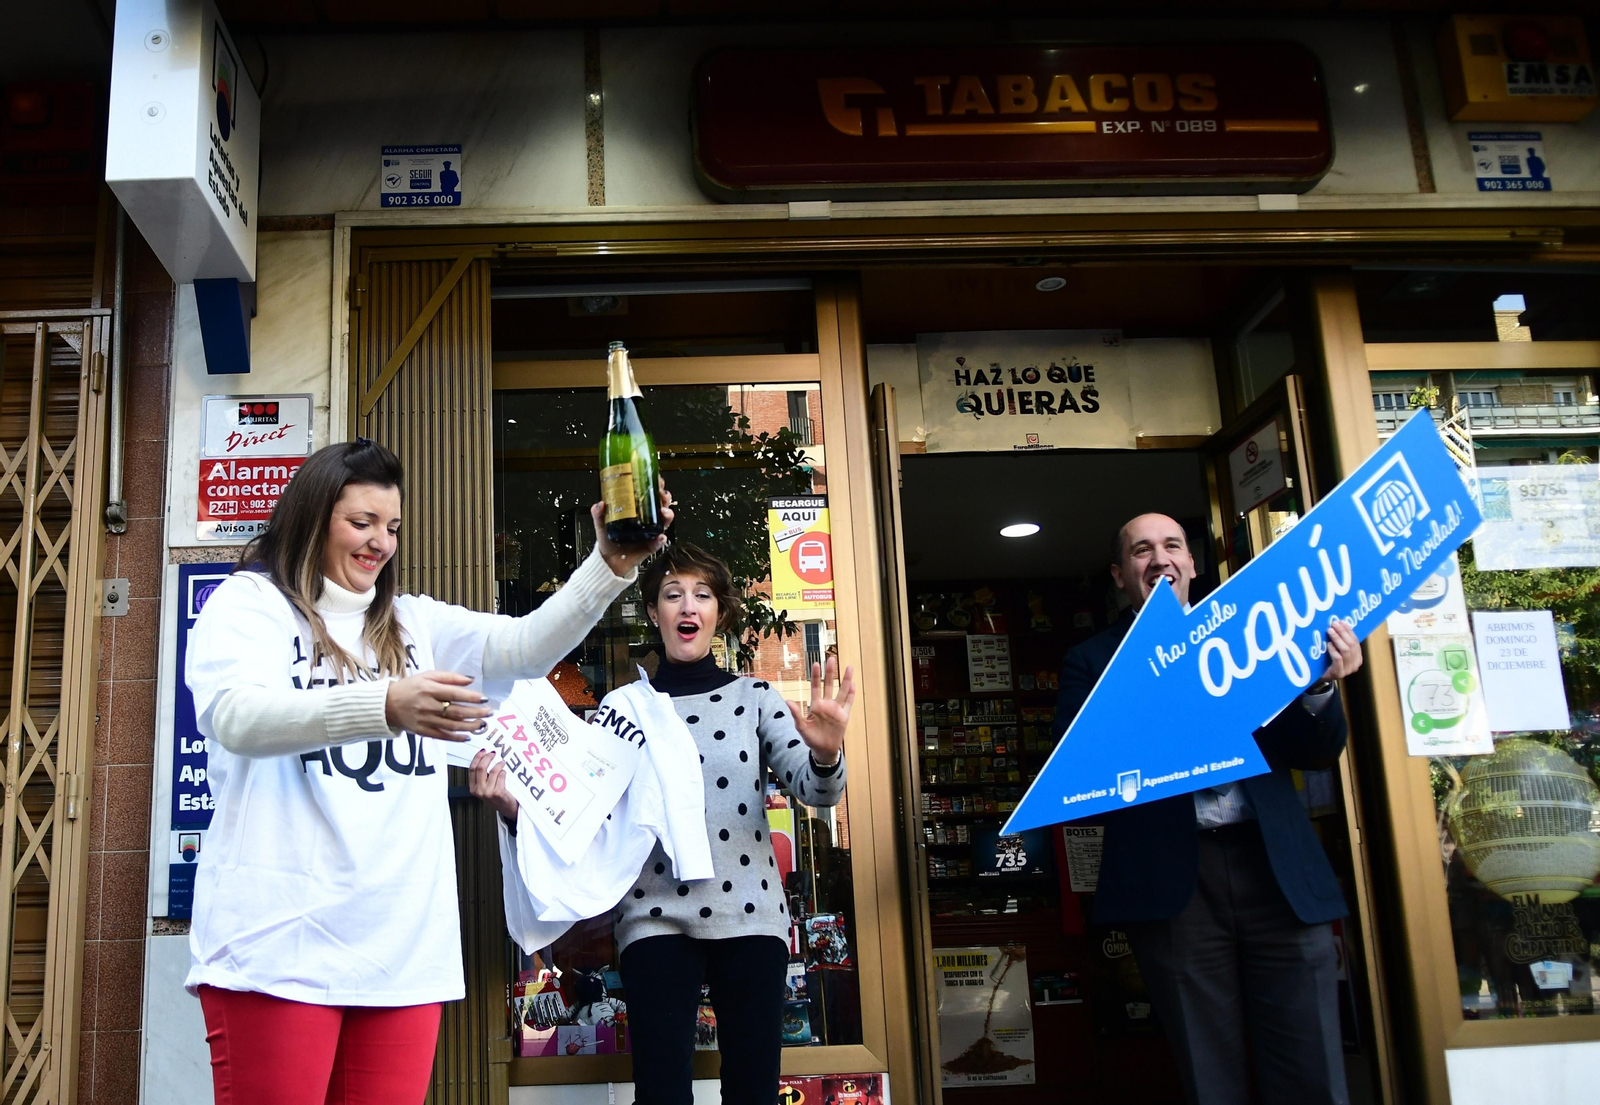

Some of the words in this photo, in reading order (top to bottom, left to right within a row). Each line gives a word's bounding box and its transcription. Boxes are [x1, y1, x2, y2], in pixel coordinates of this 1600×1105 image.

[1507, 64, 1593, 84] EMSA
[913, 73, 1218, 116] TABACOS
[1101, 121, 1144, 134] EXP.
[1175, 120, 1217, 133] 089
[409, 169, 432, 179] SEGUR
[209, 147, 238, 209] Apuestas
[239, 201, 248, 227] del
[235, 174, 240, 192] y
[1484, 181, 1503, 189] 902
[1505, 180, 1524, 189] 365
[1526, 180, 1545, 189] 000
[208, 168, 229, 218] Estado
[388, 196, 408, 205] 902
[411, 195, 430, 205] 365
[433, 195, 453, 204] 000
[954, 367, 1004, 387] HAZ
[1010, 366, 1041, 386] LO
[1047, 364, 1096, 384] QUE
[955, 387, 1101, 418] QUIERAS
[225, 423, 297, 453] Direct
[1519, 483, 1568, 497] 93756
[211, 503, 237, 514] 24H
[250, 500, 266, 509] 902
[771, 499, 825, 508] RECARGUE
[781, 509, 816, 521] AQUÍ
[215, 524, 246, 533] Aviso
[788, 527, 802, 535] BUS
[1310, 629, 1328, 660] el
[1380, 568, 1402, 595] de
[1397, 500, 1465, 575] Navidad!
[1198, 523, 1352, 697] aquí
[1486, 622, 1535, 632] ABRIMOS
[1486, 635, 1537, 645] DOMINGO
[1500, 648, 1513, 657] 23
[1515, 647, 1528, 657] DE
[1487, 660, 1547, 670] DICIEMBRE
[1421, 683, 1455, 706] 73
[180, 737, 208, 754] Lot
[497, 714, 568, 793] 03347
[1142, 770, 1190, 788] Apuestas
[1191, 764, 1208, 777] del
[1210, 757, 1245, 772] Estado
[179, 794, 216, 811] Esta
[1063, 789, 1107, 805] Loterías
[1108, 787, 1117, 797] y
[1066, 828, 1098, 837] BOTES
[1512, 895, 1526, 908] EL
[1526, 893, 1575, 920] MAYOR
[1513, 909, 1560, 941] PREMIO
[1505, 933, 1589, 964] COMPARTIRLO
[957, 954, 988, 967] MILLONES
